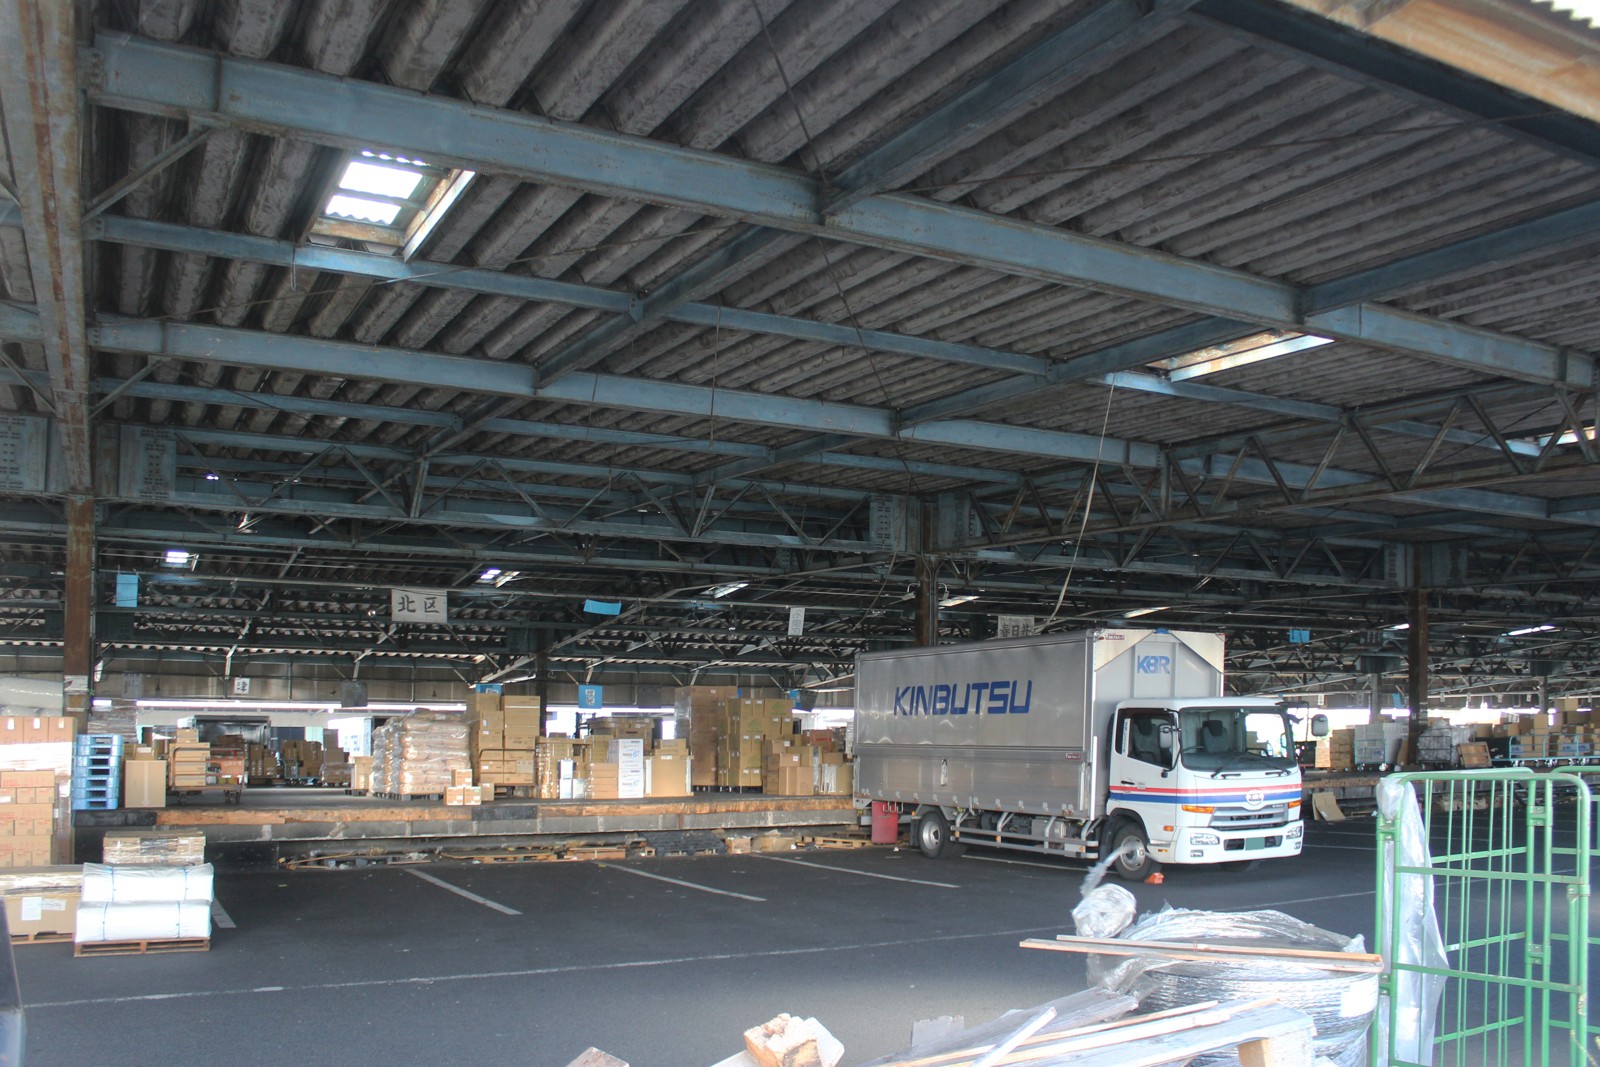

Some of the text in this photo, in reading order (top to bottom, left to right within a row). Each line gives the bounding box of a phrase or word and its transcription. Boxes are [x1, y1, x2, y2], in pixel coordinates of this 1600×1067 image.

[398, 594, 440, 614] 北区
[1137, 655, 1171, 675] KBR
[893, 680, 1033, 716] KINBUTSU
